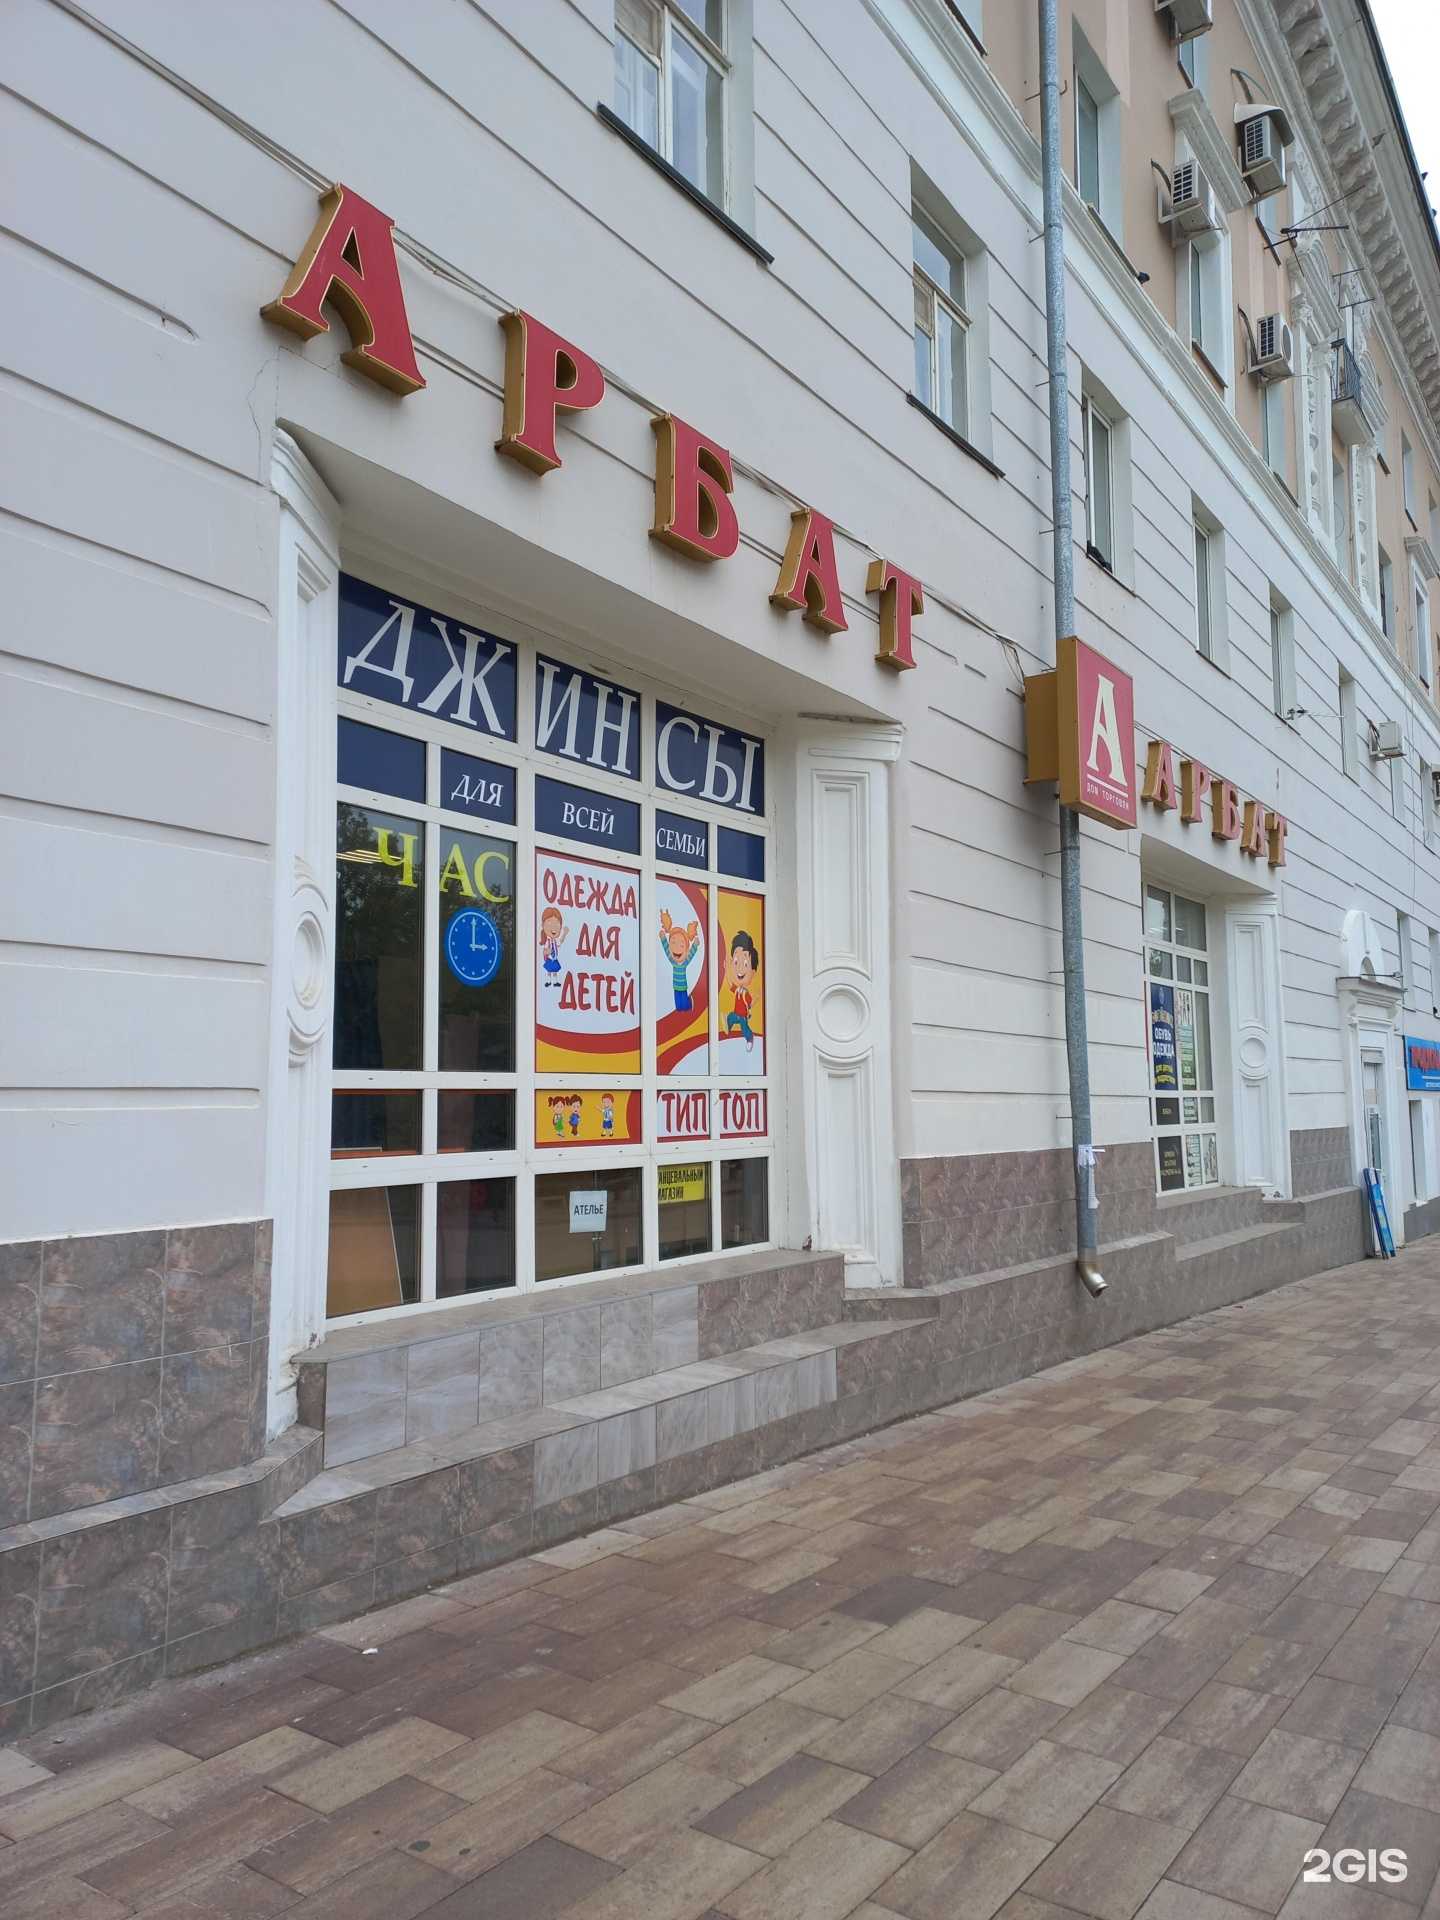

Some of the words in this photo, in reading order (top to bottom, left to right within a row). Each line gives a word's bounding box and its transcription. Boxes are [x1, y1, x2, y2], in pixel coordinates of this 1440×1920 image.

[260, 183, 924, 671] АРБАТ
[343, 600, 760, 812] ДЖИНСЫ
[1086, 673, 1128, 787] А
[451, 774, 504, 807] ДЛЯ
[562, 802, 615, 835] ВСЕЙ
[656, 828, 706, 857] СЕМЬИ
[1141, 740, 1288, 867] АРБАТ
[372, 826, 510, 903] ЧАС
[543, 868, 637, 919] ОДЕЖДА
[576, 923, 621, 960] ДЛЯ
[559, 971, 635, 1015] ДЕТЕЙ
[661, 1092, 707, 1133] ТИП
[719, 1092, 760, 1130] ТОП
[574, 1204, 604, 1216] АТЕЛЬЕ
